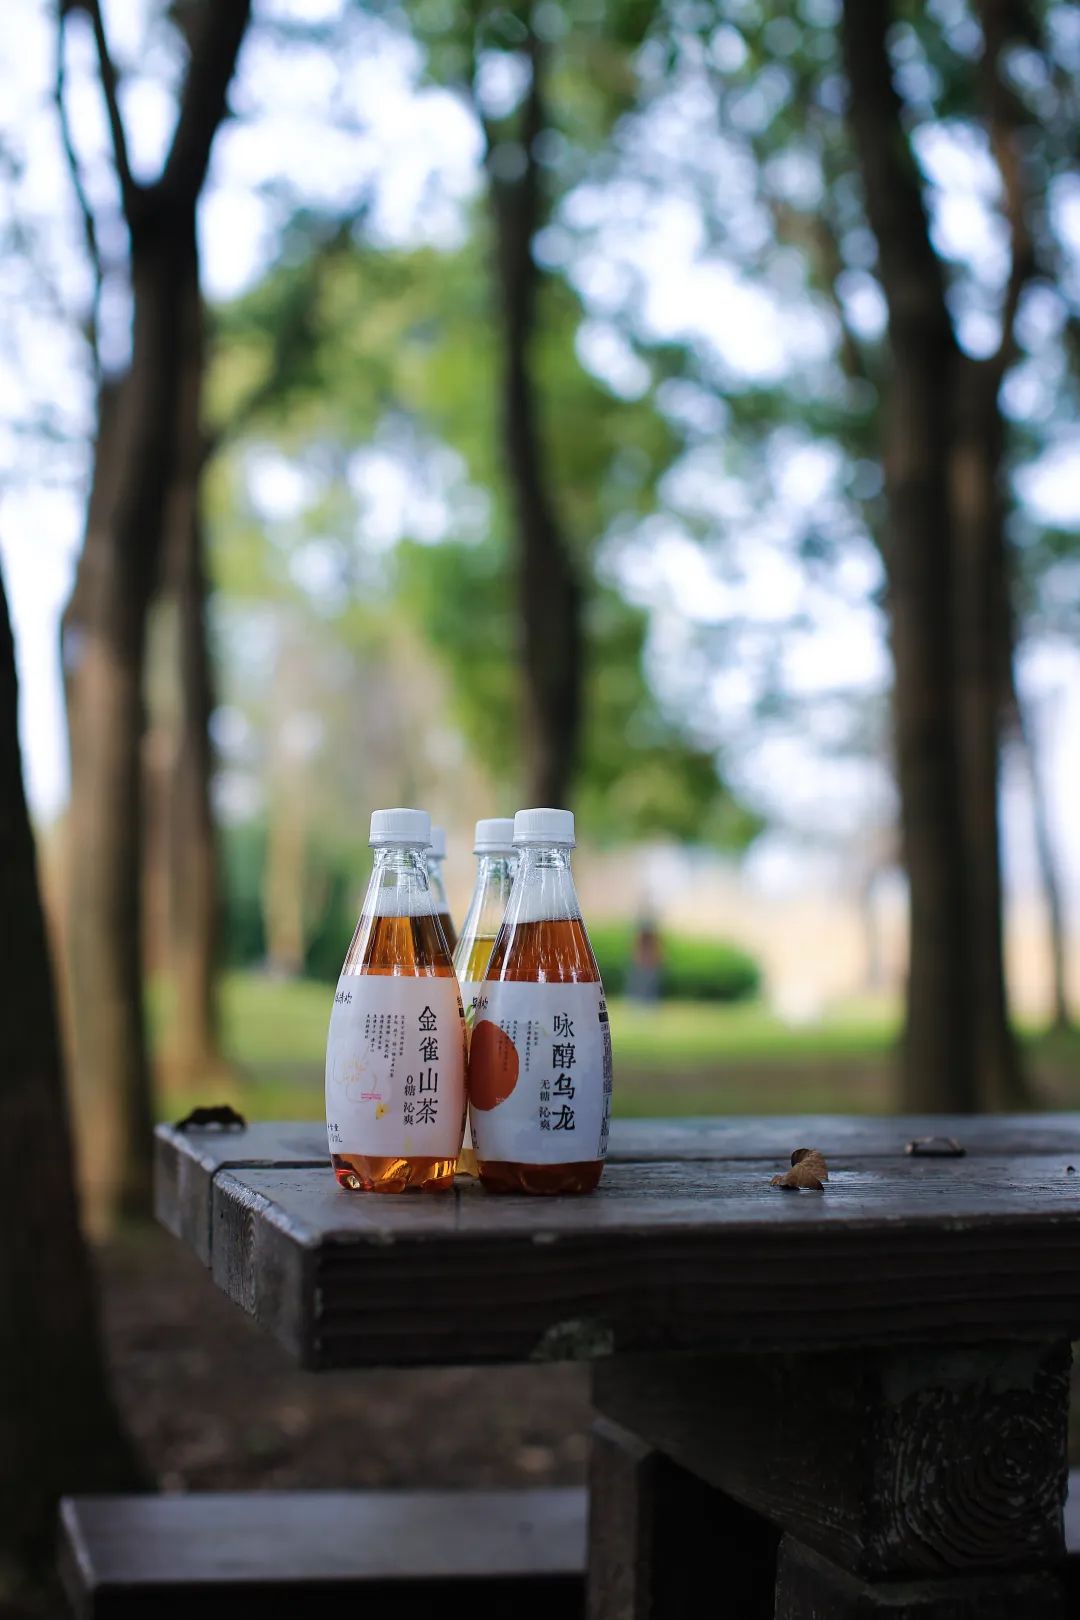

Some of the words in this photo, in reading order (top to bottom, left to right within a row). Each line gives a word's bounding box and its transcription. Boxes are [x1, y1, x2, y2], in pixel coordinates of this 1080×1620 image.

[416, 1006, 439, 1124] 金雀山茶
[552, 1012, 576, 1131] 咏醇乌龙
[540, 1080, 551, 1102] 无糖
[403, 1102, 415, 1125] 沁爽
[539, 1106, 551, 1131] 沁爽
